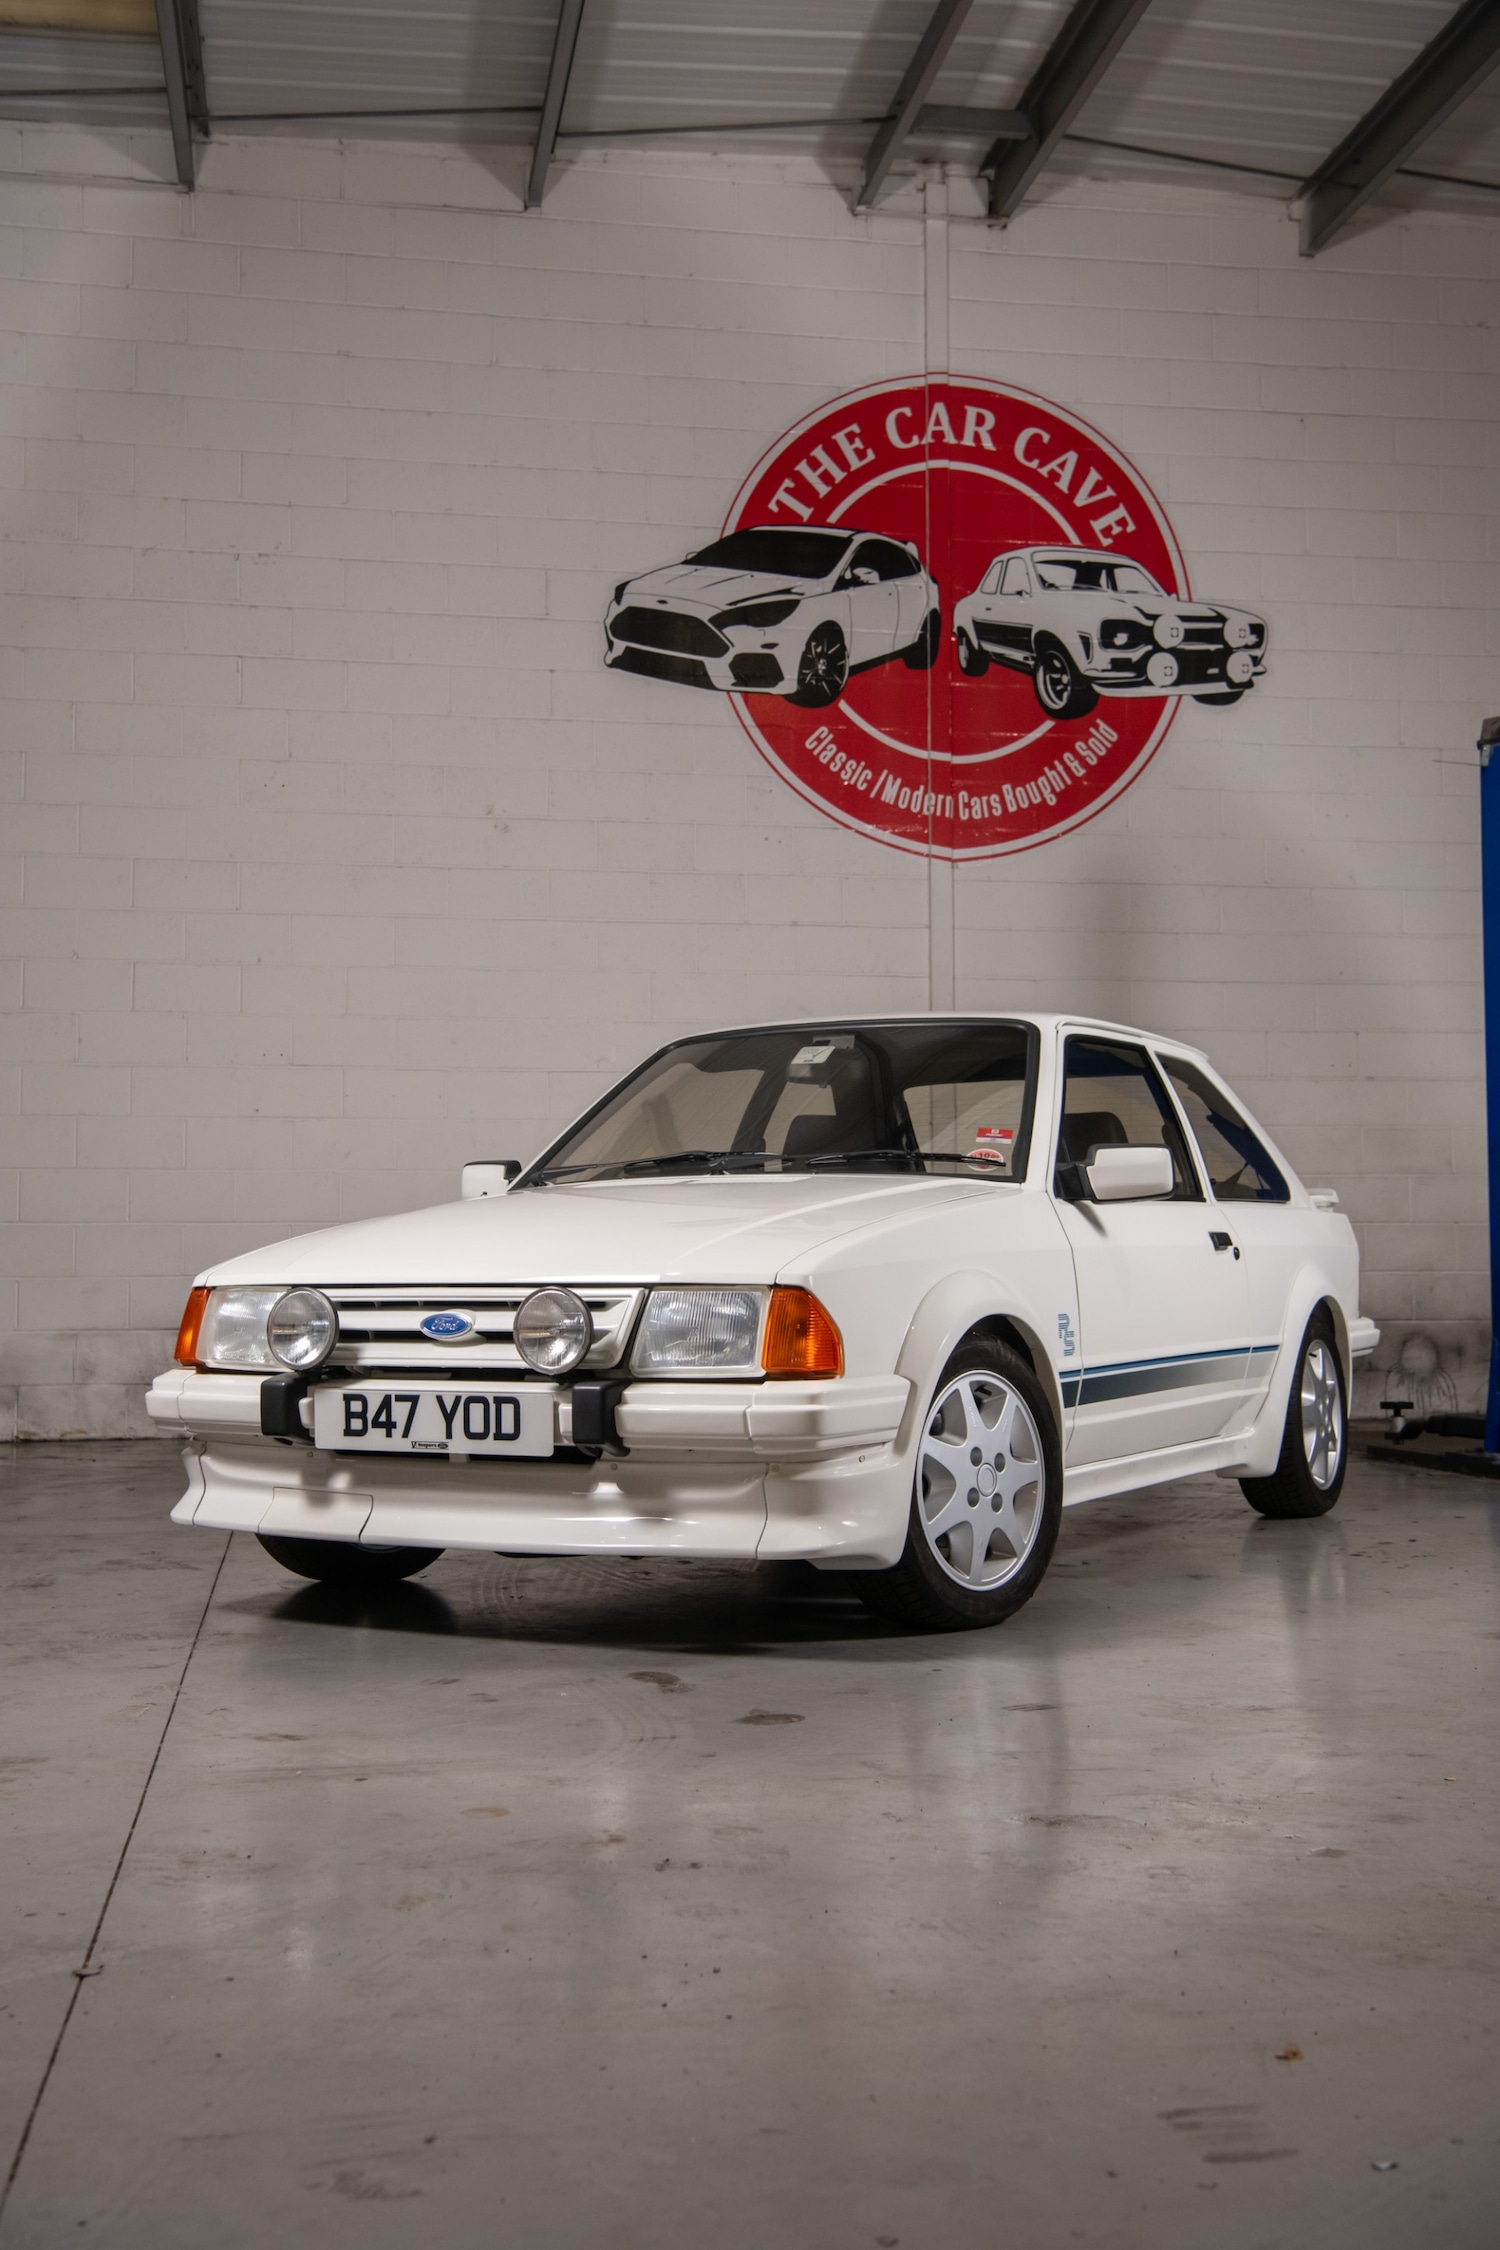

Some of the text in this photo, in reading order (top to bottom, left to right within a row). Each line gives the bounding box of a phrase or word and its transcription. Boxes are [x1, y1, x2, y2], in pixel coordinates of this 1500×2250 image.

[768, 402, 1136, 547] THE CAR CAVE
[804, 725, 873, 792] Classic
[958, 790, 1003, 821] Cars
[1001, 759, 1073, 807] Bought
[1063, 752, 1087, 777] &
[1075, 718, 1119, 767] Sold
[431, 1317, 460, 1331] Ford
[343, 1393, 521, 1441] B47 YOD
